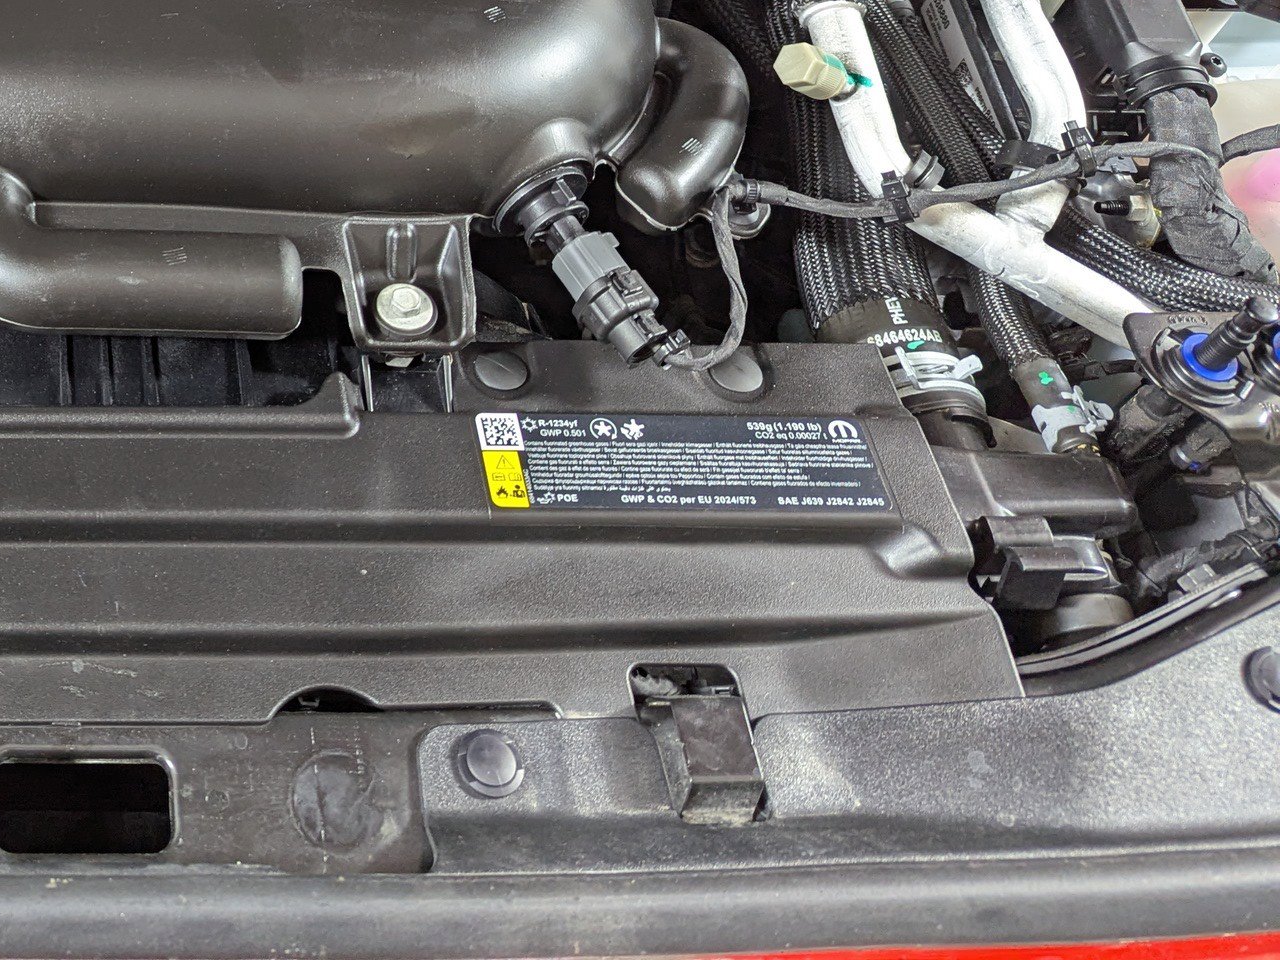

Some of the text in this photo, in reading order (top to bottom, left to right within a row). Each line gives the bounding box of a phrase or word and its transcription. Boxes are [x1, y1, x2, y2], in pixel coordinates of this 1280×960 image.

[538, 419, 578, 428] R-1234yf
[807, 422, 822, 432] lb)
[540, 429, 587, 437] GWP 0.501
[789, 432, 821, 440] 0.00027
[557, 494, 579, 503] POE
[621, 495, 756, 505] GWP & CO2 per EU 2024/573
[777, 497, 885, 506] SAE J639 J2842 J2845
